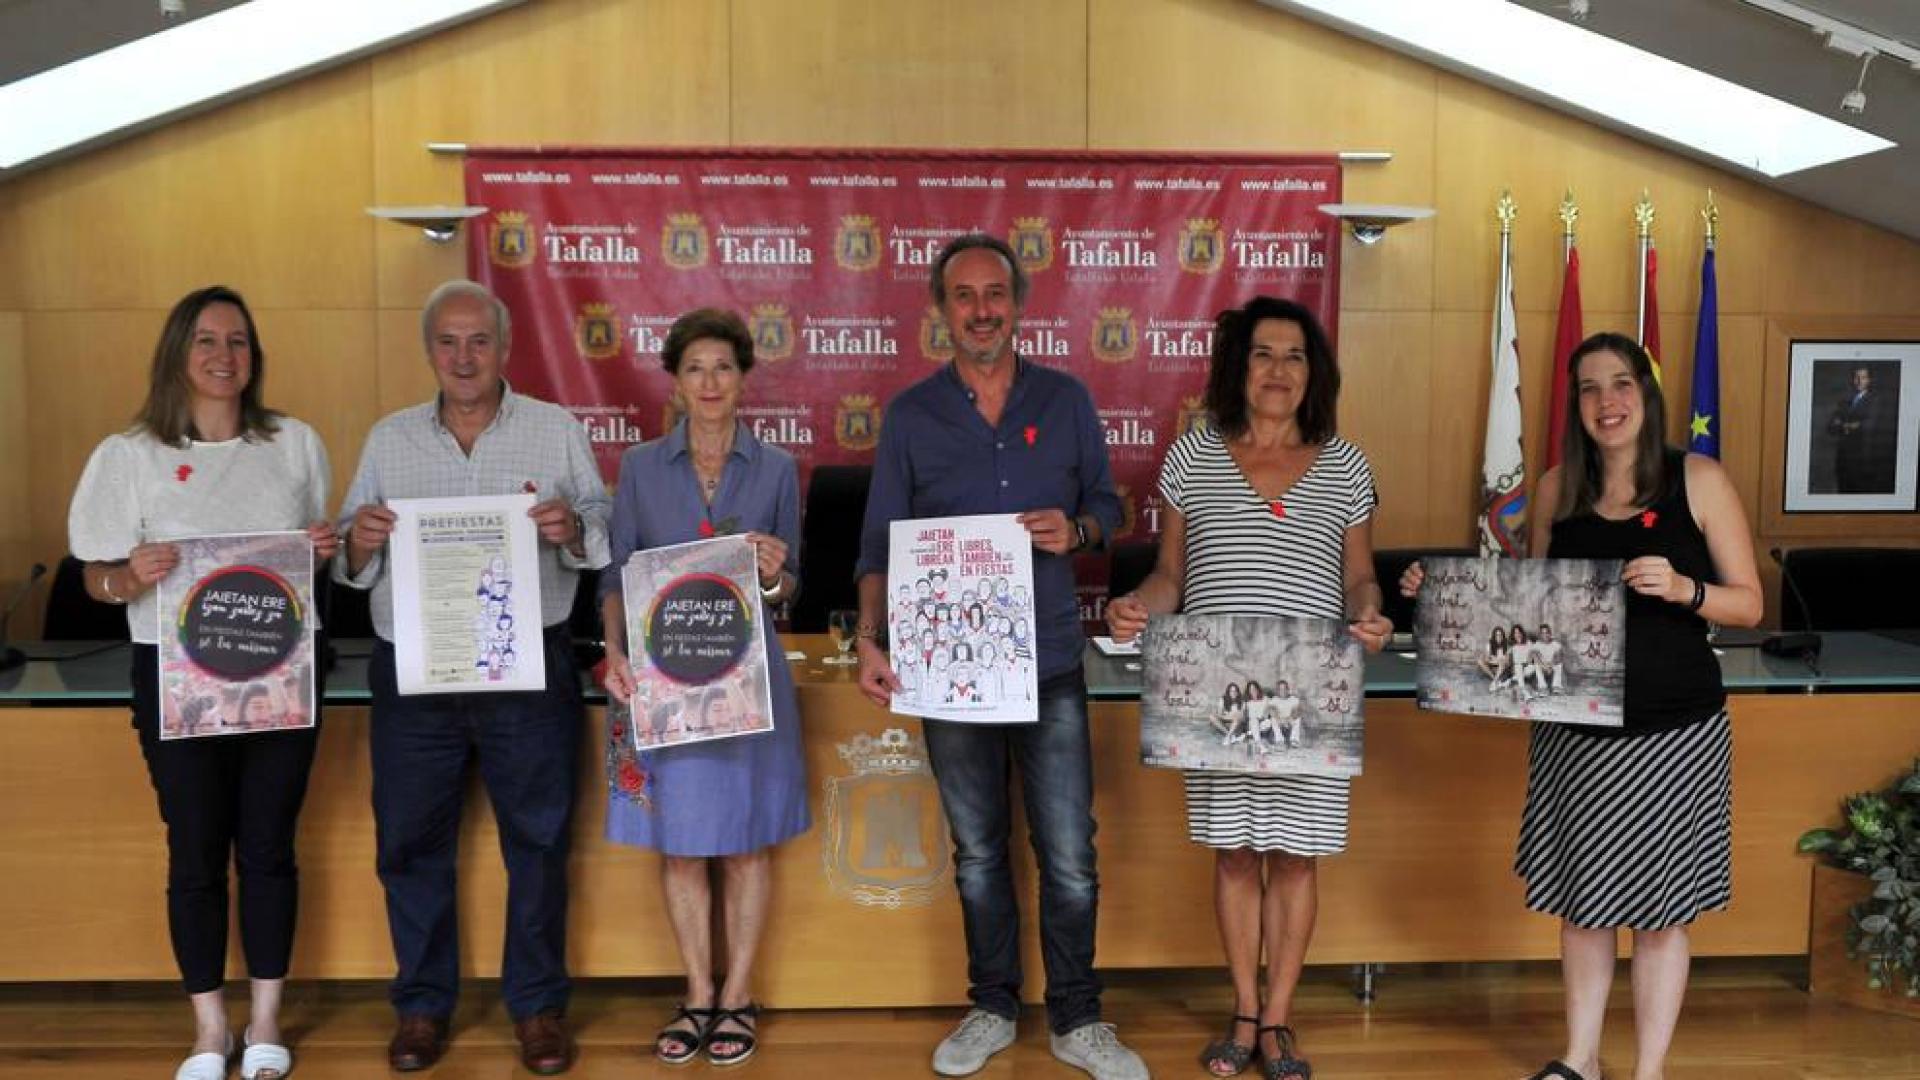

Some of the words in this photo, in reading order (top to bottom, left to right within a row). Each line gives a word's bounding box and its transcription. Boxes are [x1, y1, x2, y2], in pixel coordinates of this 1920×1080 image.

[482, 172, 571, 184] www.tafalla.es
[592, 172, 680, 185] www.tafalla.es
[701, 174, 789, 186] www.tafalla.es
[810, 175, 898, 187] www.tafalla.es
[918, 176, 1007, 188] www.tafalla.es
[1026, 177, 1114, 189] www.tafalla.es
[1134, 178, 1221, 190] www.tafalla.es
[1240, 179, 1328, 192] www.tafalla.es
[1140, 227, 1157, 240] de
[543, 235, 641, 263] Tafalla
[716, 237, 813, 265] Tafalla
[1062, 240, 1159, 267] Tafalla
[1231, 242, 1325, 268] Tafalla
[802, 328, 899, 355] Tafalla
[1012, 329, 1070, 356] alla
[1145, 331, 1214, 357] Tafal
[583, 416, 642, 443] falla
[753, 418, 816, 445] falla
[1099, 418, 1155, 446] alla
[419, 516, 504, 528] PREFIESTAS
[959, 538, 992, 552] LIBRES
[959, 563, 974, 577] EN
[975, 562, 1015, 576] FIESTAS
[203, 590, 259, 606] JAIETAN
[262, 595, 288, 609] ERE
[663, 599, 713, 612] JAIETAN
[715, 599, 737, 611] ERE
